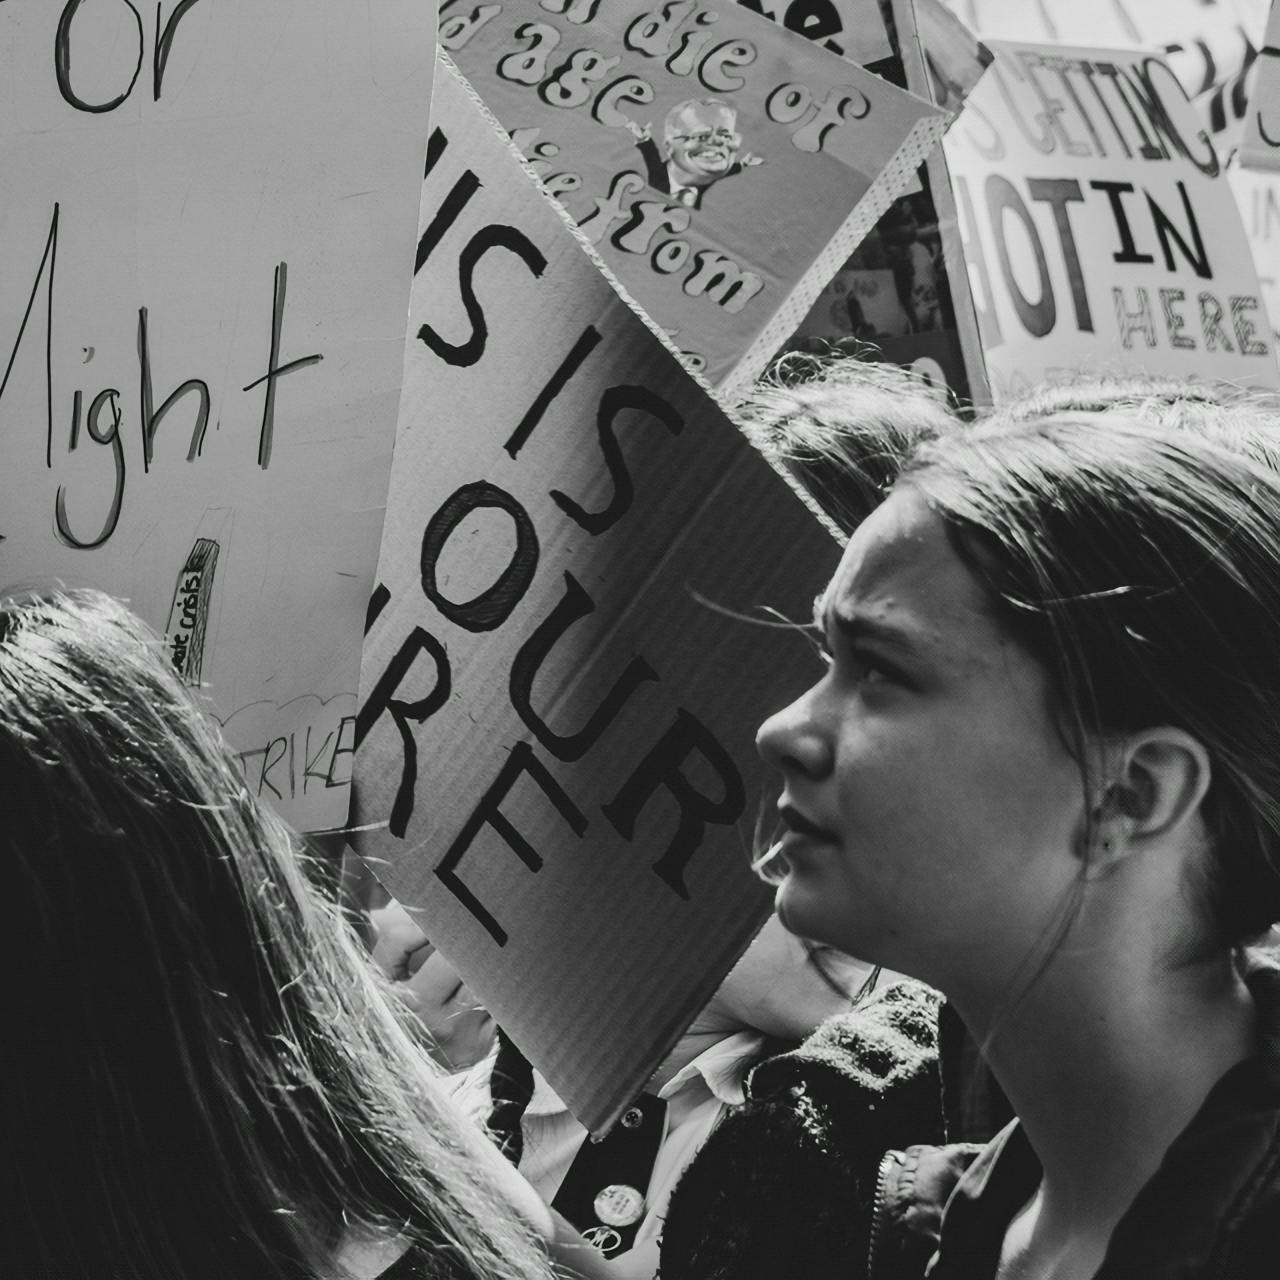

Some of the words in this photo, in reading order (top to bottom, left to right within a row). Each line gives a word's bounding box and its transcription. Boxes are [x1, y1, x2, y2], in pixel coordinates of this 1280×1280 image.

[496, 22, 656, 127] age
[624, 0, 758, 93] die
[765, 82, 871, 153] of
[1089, 179, 1215, 281] IN
[1112, 285, 1270, 357] HERE
[422, 479, 747, 901] OUR
